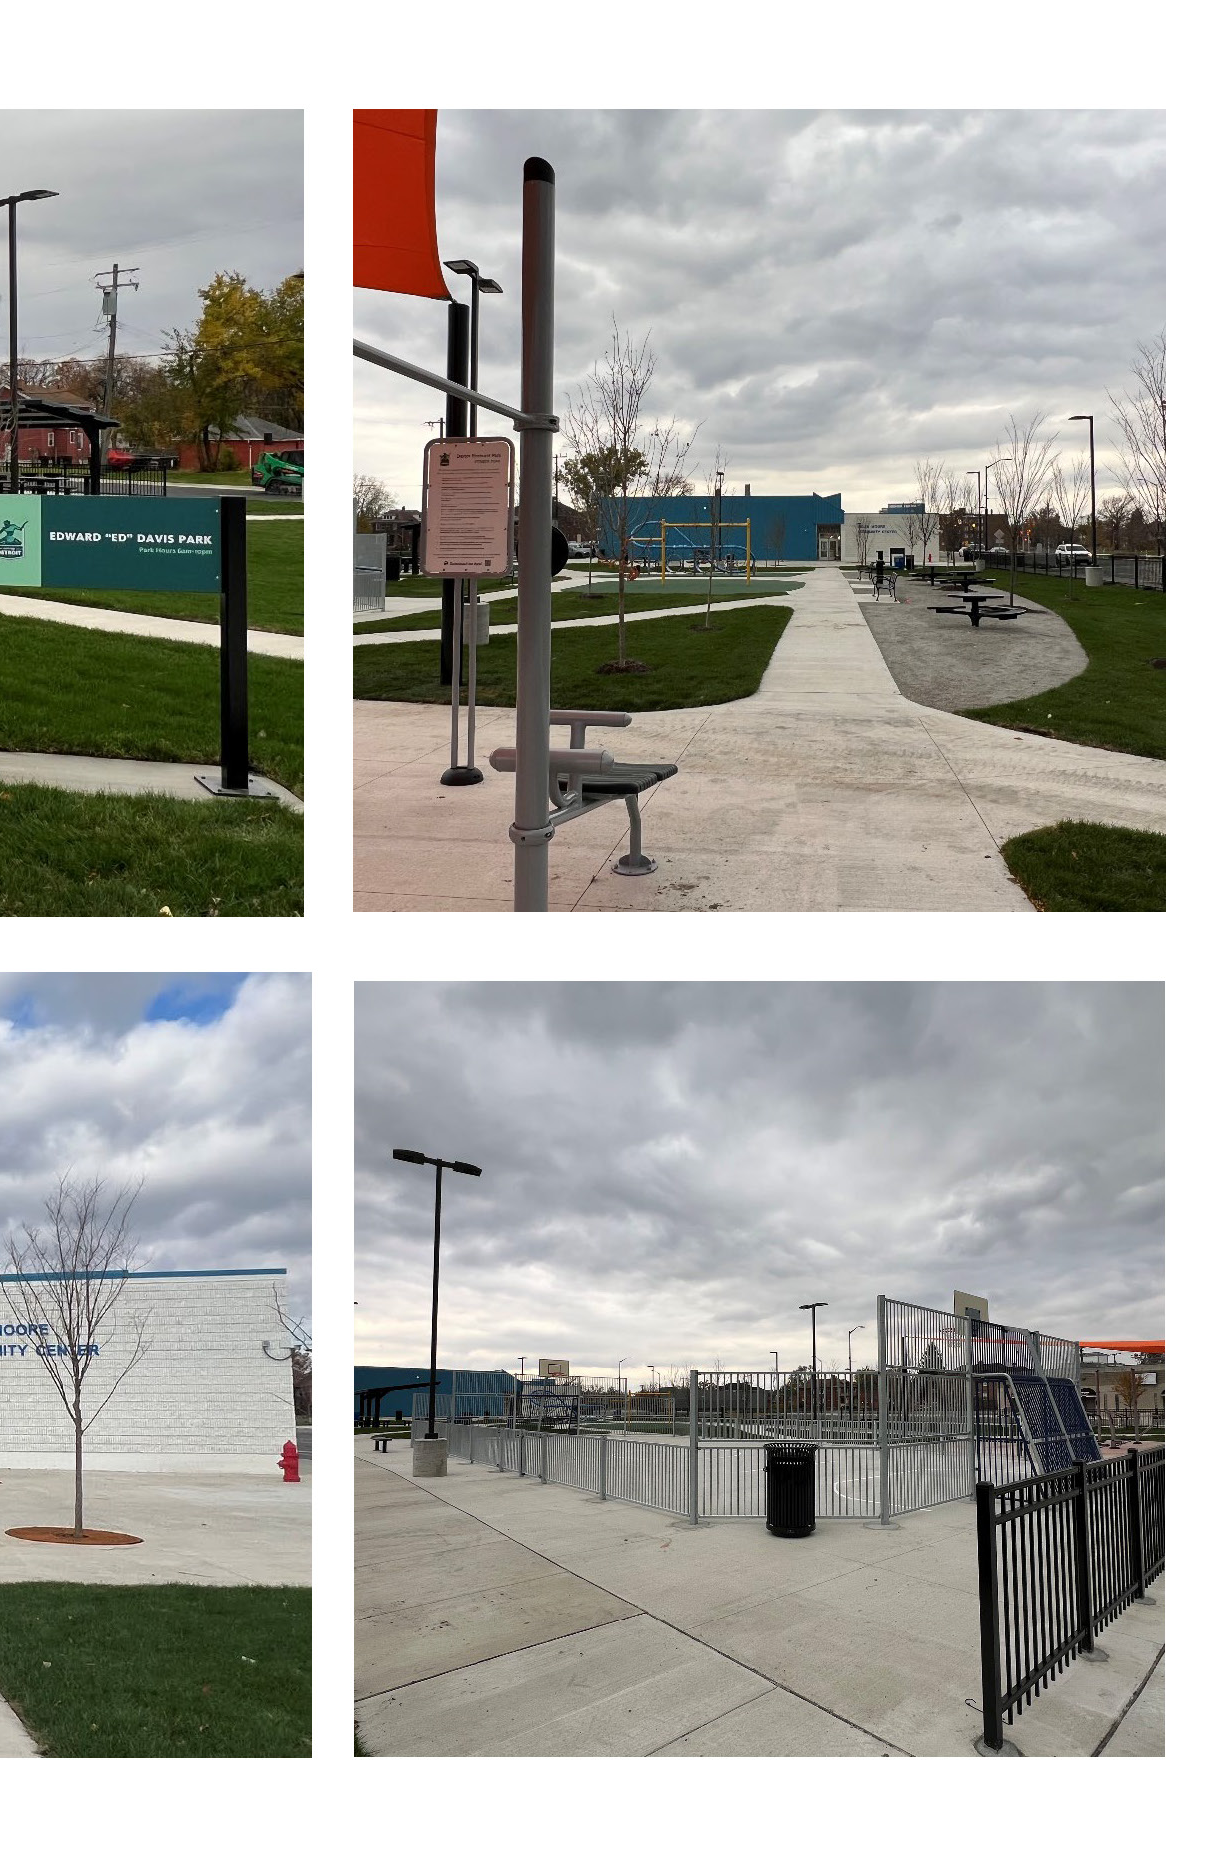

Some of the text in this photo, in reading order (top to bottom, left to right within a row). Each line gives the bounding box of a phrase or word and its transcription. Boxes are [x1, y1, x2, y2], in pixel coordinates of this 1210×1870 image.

[49, 531, 213, 545] EDWARD “ED” DAVIS PARK
